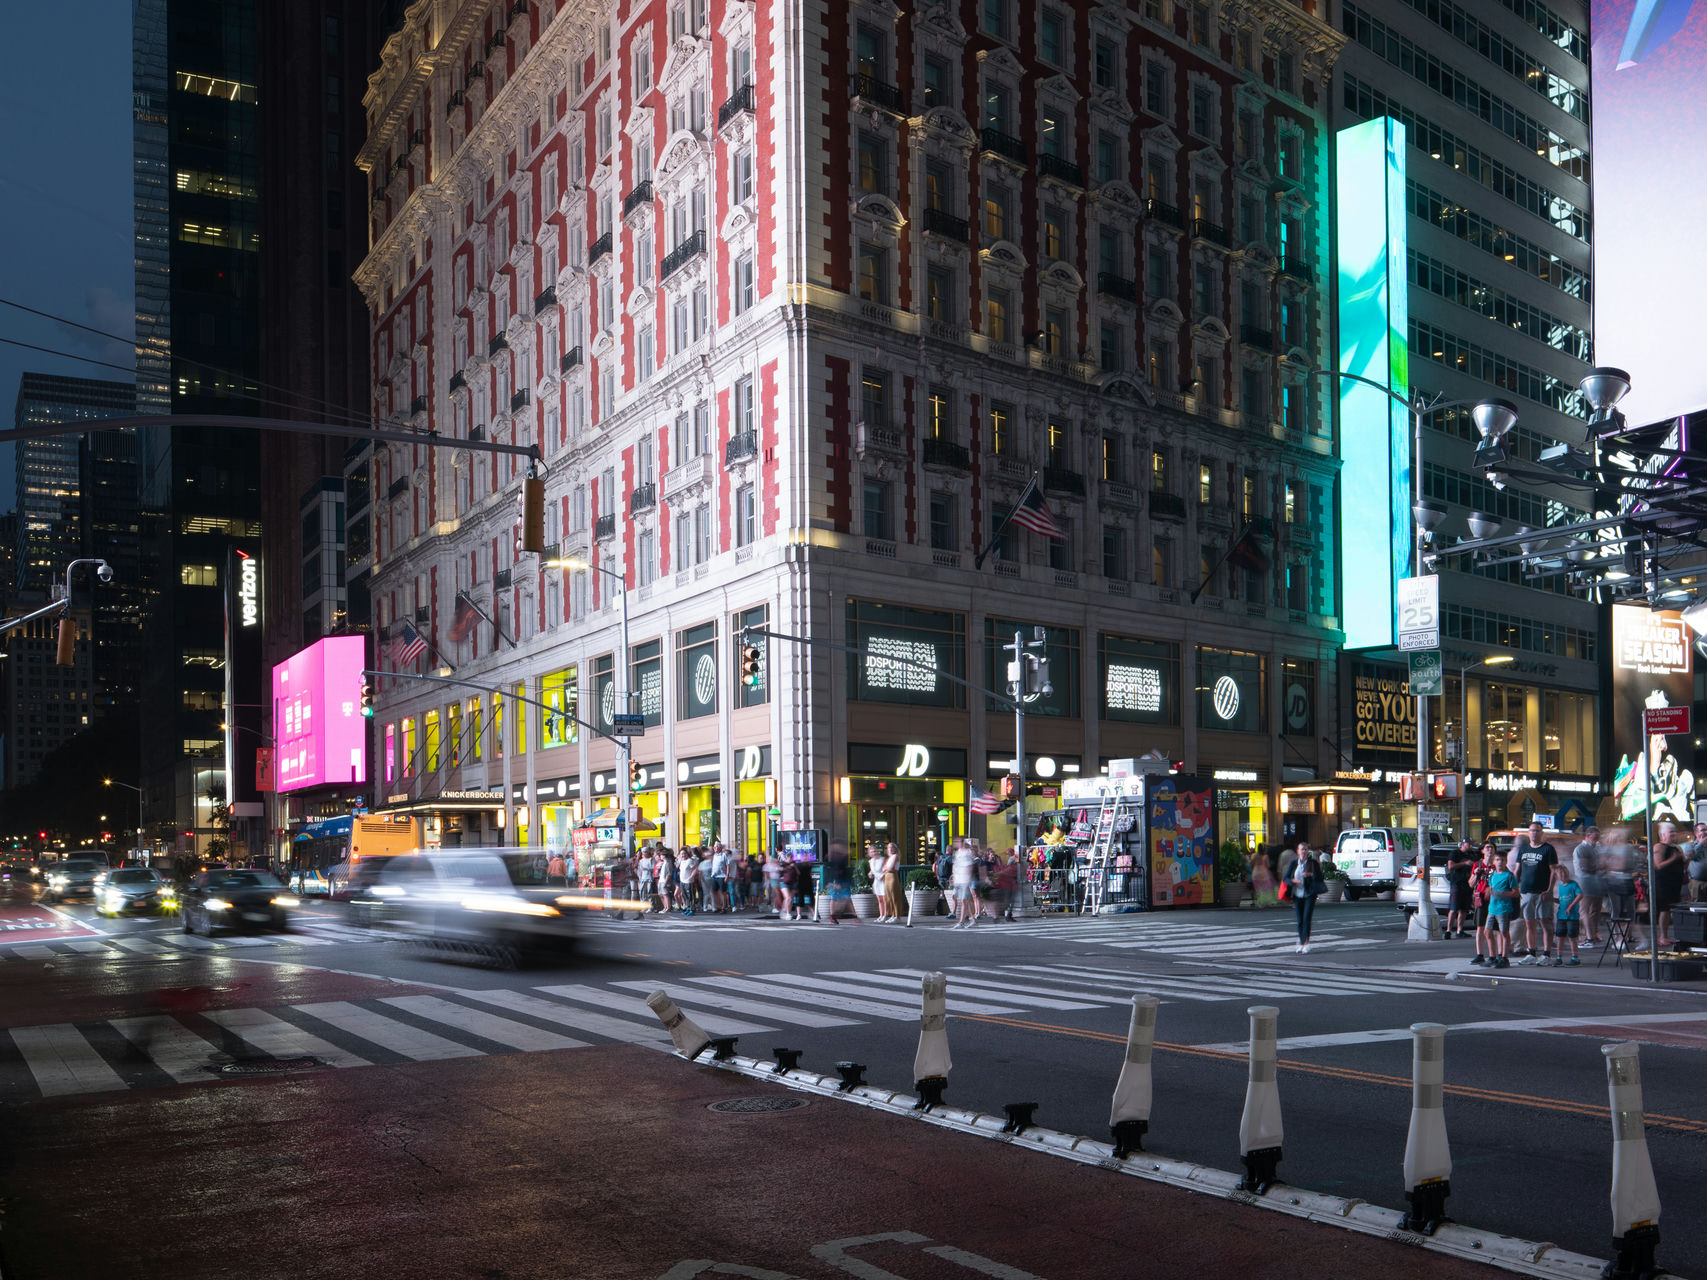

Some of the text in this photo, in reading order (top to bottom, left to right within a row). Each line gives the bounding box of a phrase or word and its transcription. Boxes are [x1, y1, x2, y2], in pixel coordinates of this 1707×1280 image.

[239, 559, 257, 626] verizon
[1409, 597, 1427, 605] LIMIT
[1404, 606, 1433, 627] 25
[1402, 639, 1435, 648] ENFORCED
[1408, 633, 1429, 641] PHOTO
[1624, 641, 1683, 665] SEASON
[1106, 681, 1160, 696] JDSPORTS.COM
[1356, 676, 1375, 689] NEW
[1377, 679, 1399, 692] YORK
[1356, 693, 1417, 723] GOT YOU
[1356, 720, 1417, 745] COVERED
[739, 745, 761, 779] JD
[896, 744, 929, 777] JD
[1488, 773, 1537, 790] Foot Locker
[441, 790, 504, 799] KNICKERBOCKER
